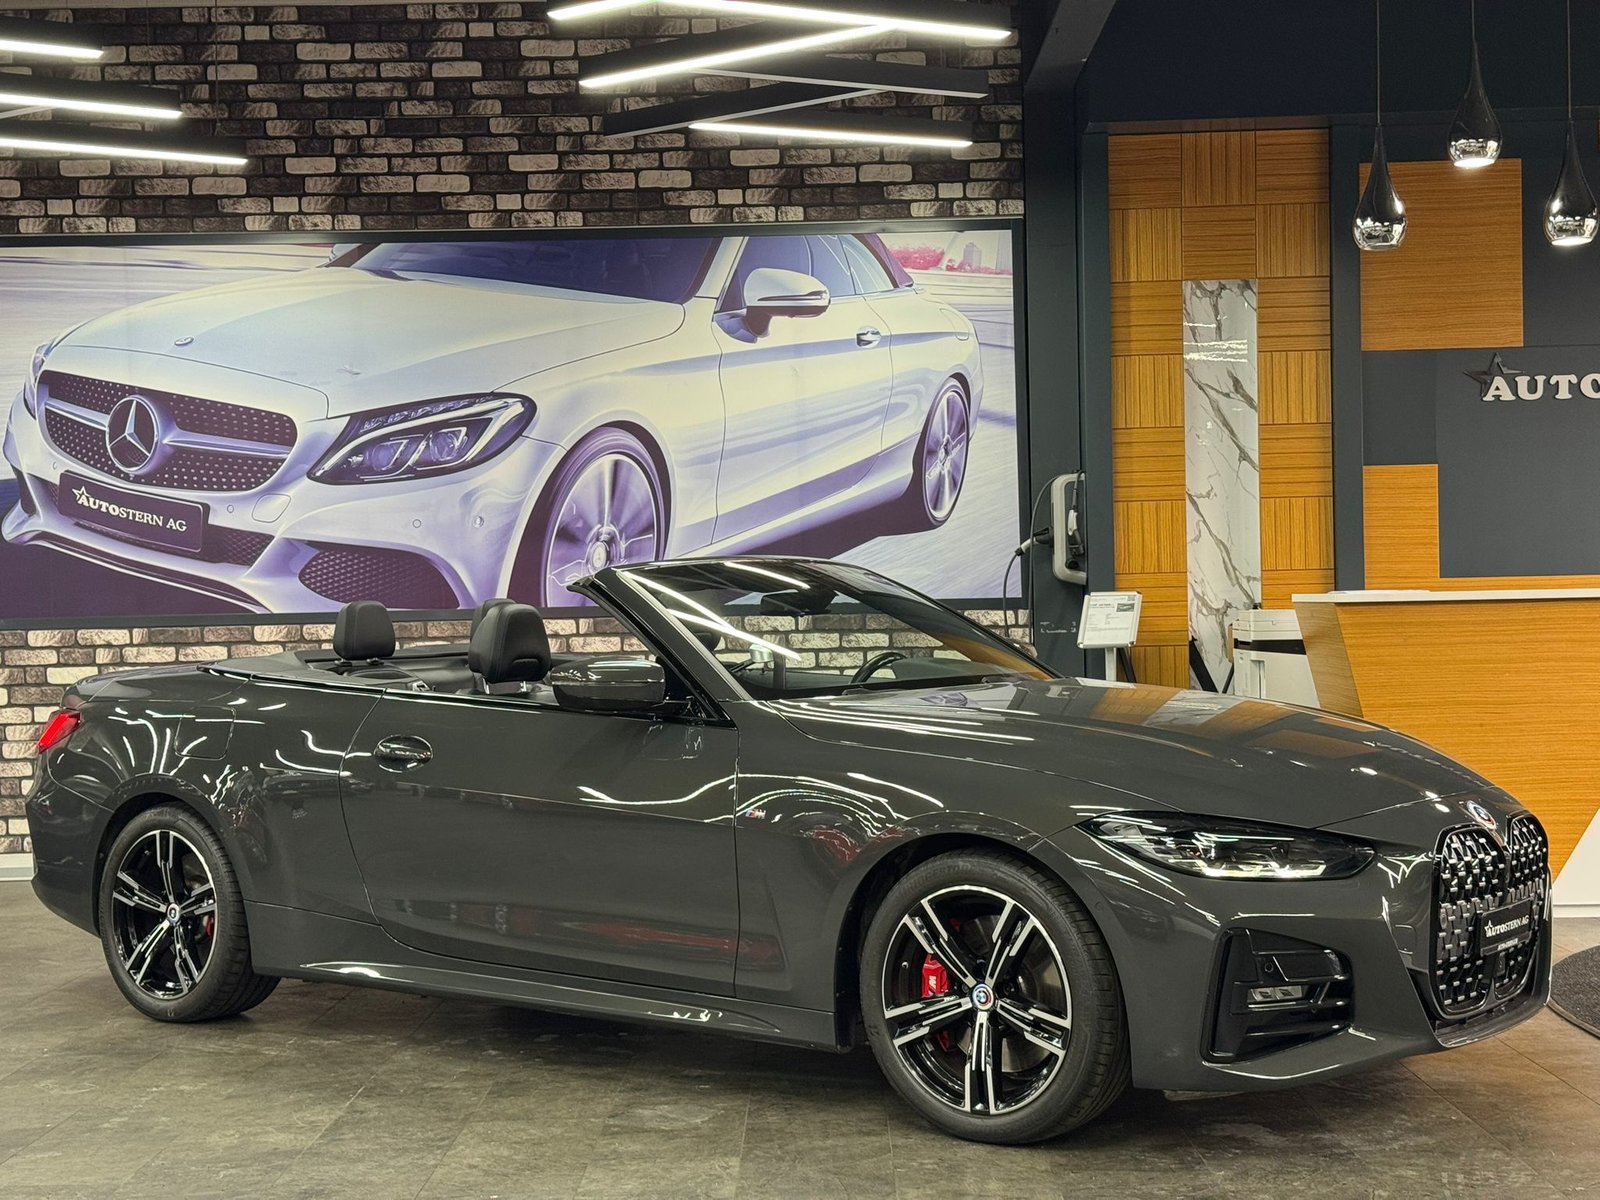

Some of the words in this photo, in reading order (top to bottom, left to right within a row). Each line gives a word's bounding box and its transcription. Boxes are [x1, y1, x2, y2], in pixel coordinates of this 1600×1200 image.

[77, 494, 163, 526] AUTOSTERN
[166, 518, 187, 531] AG
[1485, 918, 1521, 937] AUTOSTERN
[1521, 915, 1529, 925] AG
